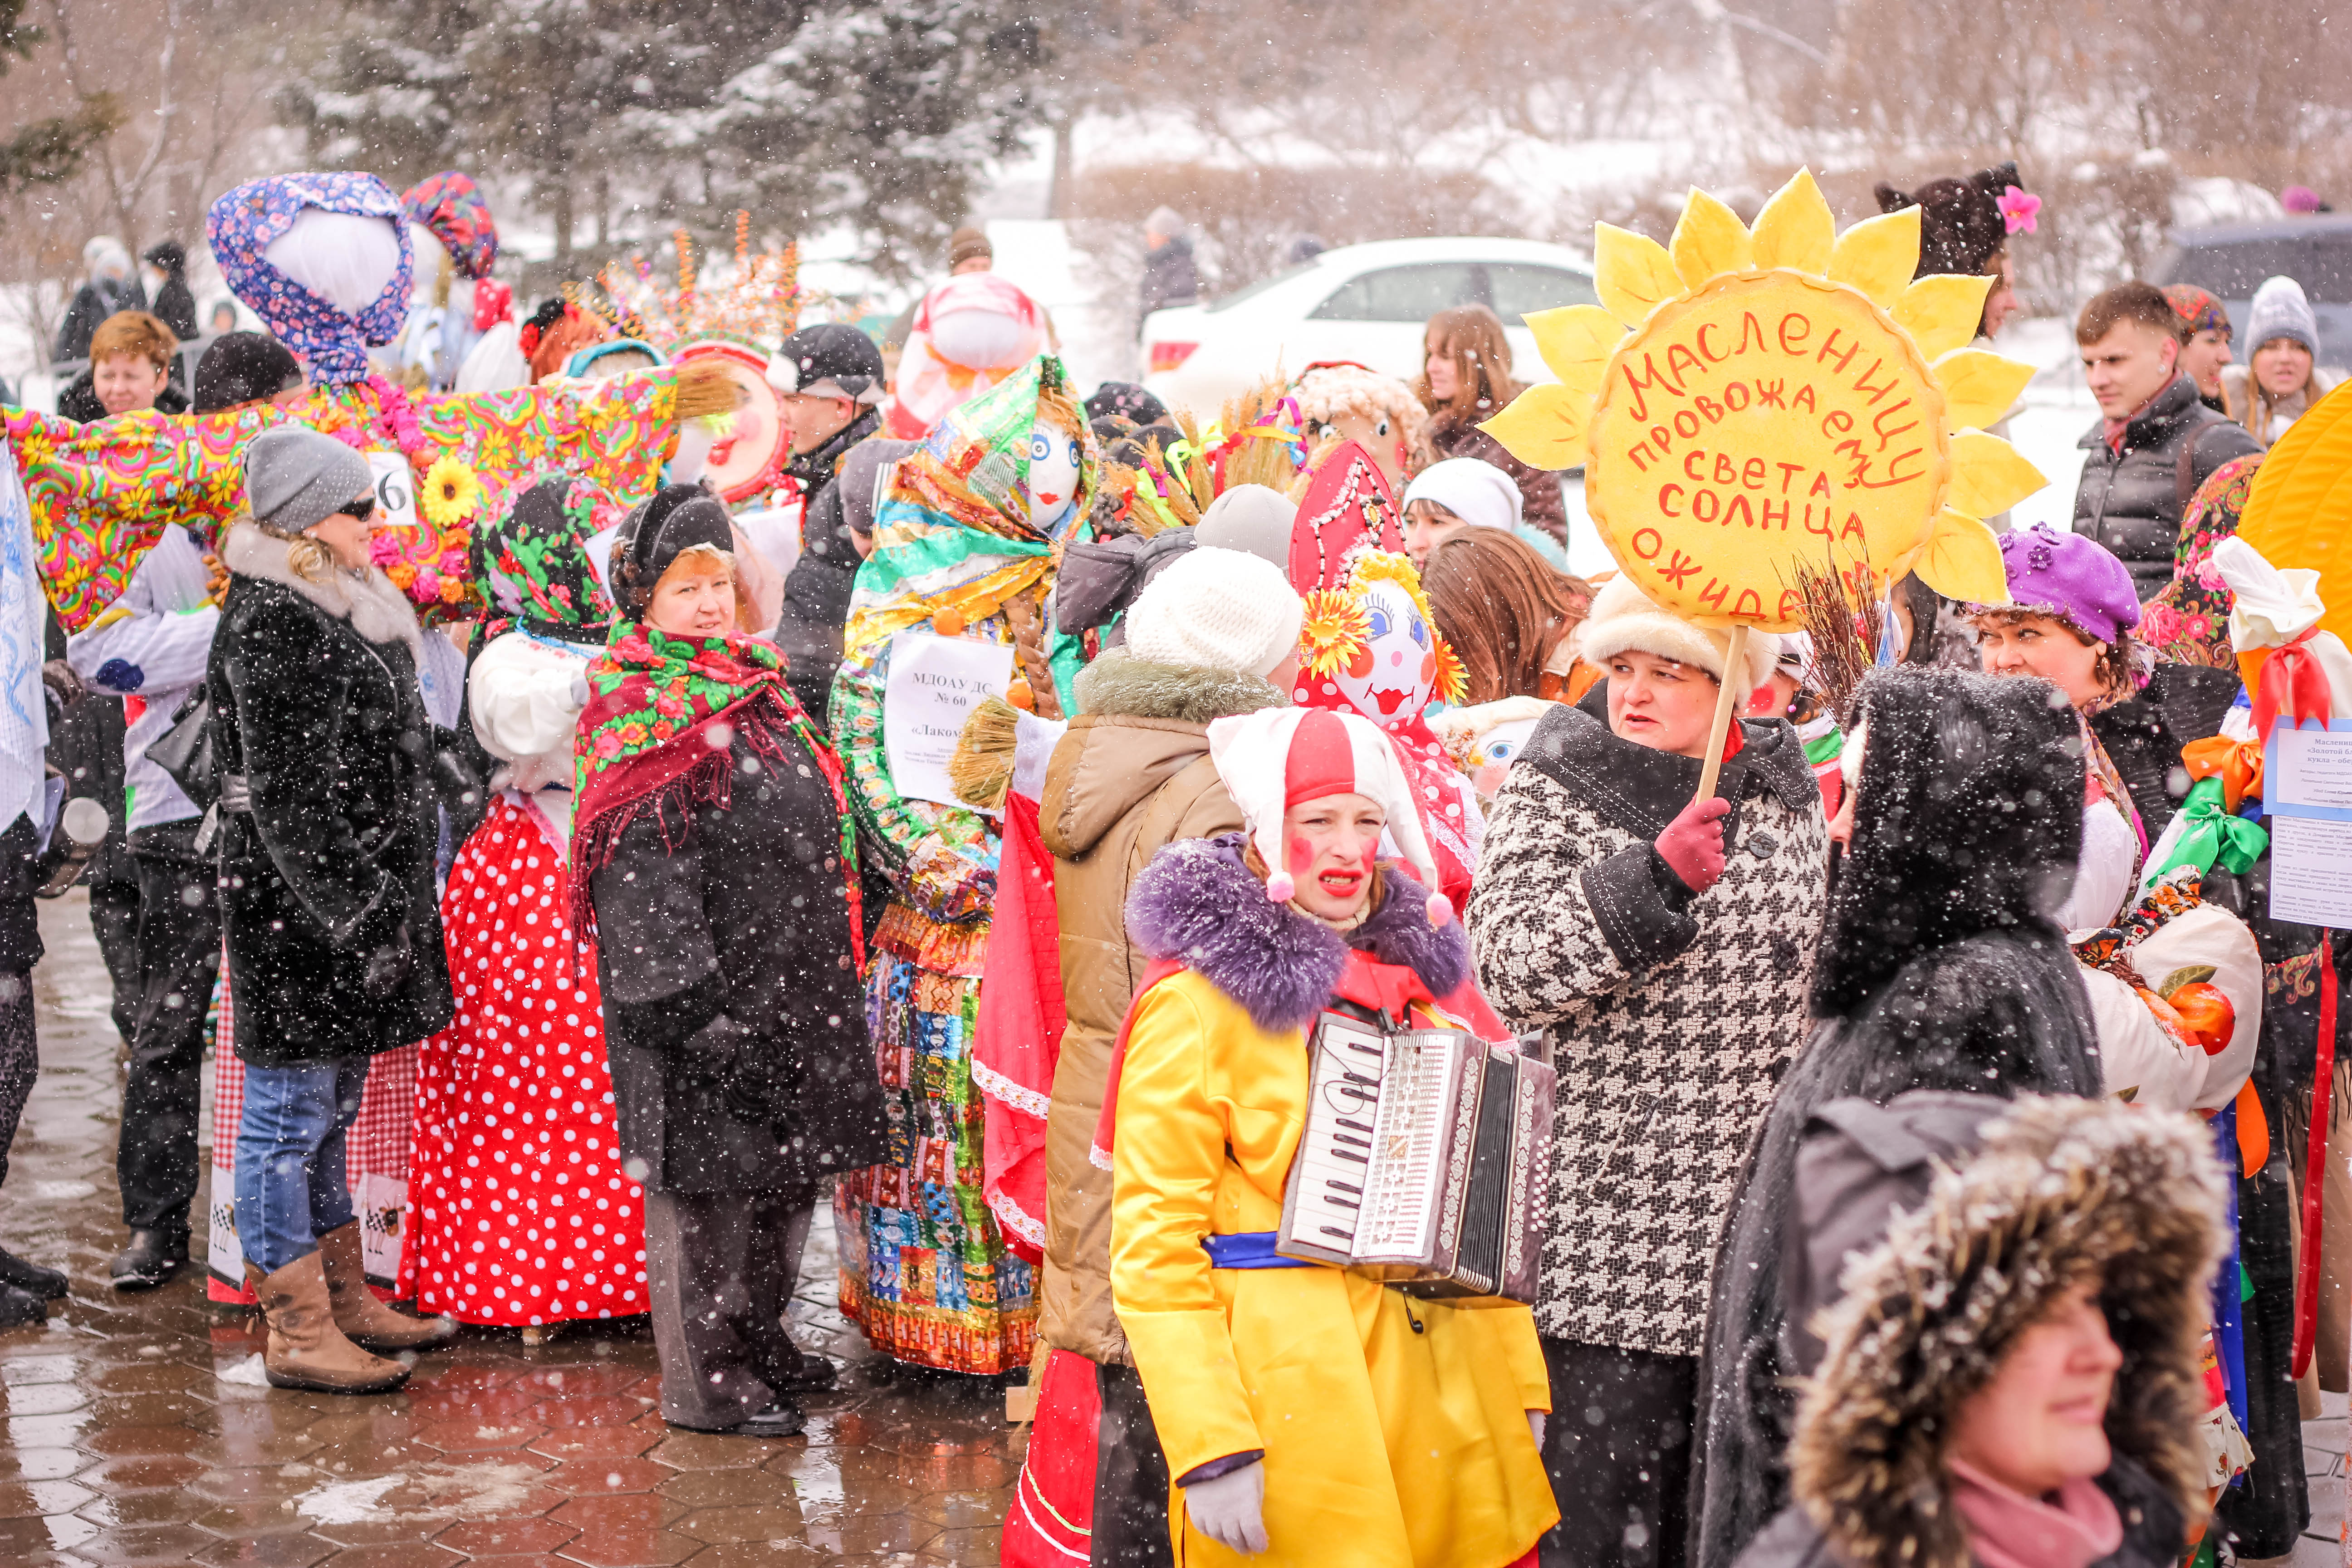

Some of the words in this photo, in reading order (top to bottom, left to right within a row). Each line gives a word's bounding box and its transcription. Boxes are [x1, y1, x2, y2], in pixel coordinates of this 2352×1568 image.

[379, 468, 406, 511] 6
[1659, 484, 1865, 542] СОЛНЦА
[912, 672, 968, 689] МДОАУ
[970, 681, 992, 694] ДС
[952, 696, 966, 706] 60
